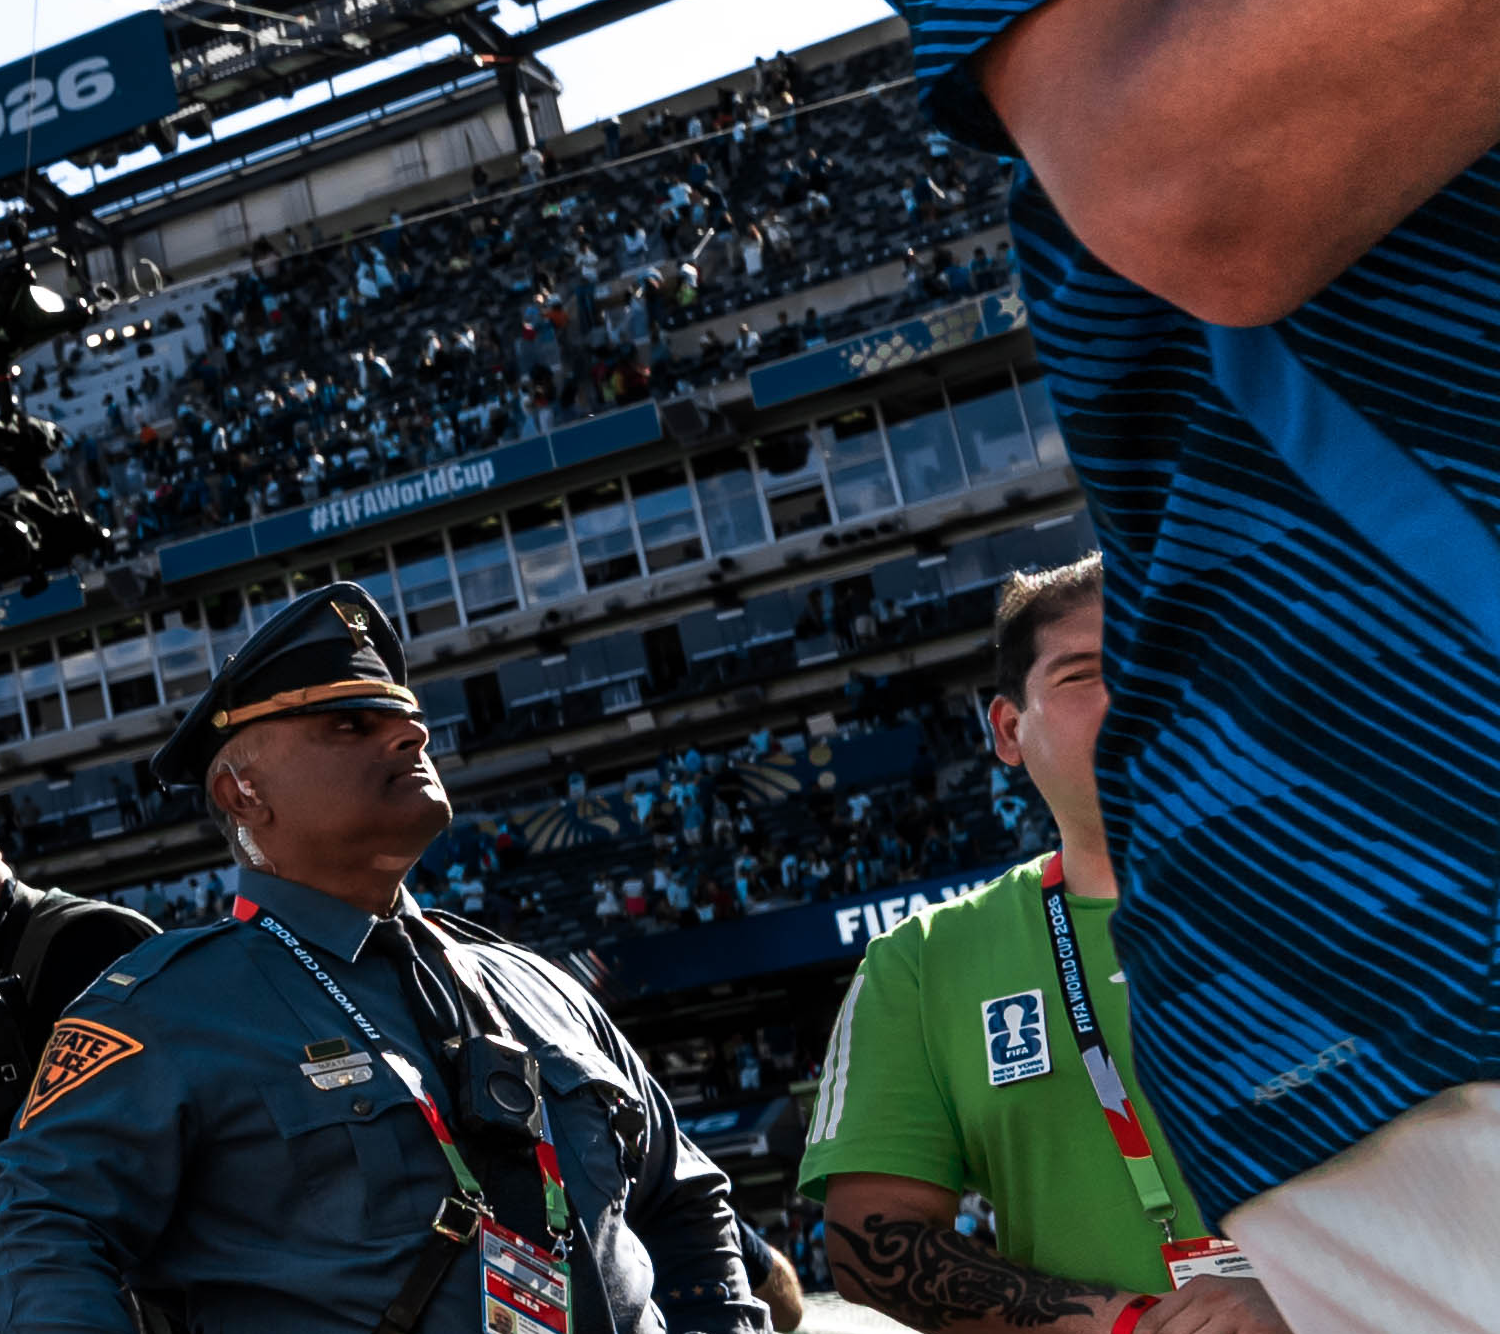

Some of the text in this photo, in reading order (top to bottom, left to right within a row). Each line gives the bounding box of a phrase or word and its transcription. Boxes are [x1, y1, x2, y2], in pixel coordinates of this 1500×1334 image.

[309, 458, 496, 534] #FIFAWorldCup
[260, 916, 380, 1040] FIFA WORLD CUP 2026
[1047, 894, 1093, 1033] FIFA WORLD CUP 2026
[53, 1029, 109, 1060] STATE
[1005, 1046, 1029, 1058] FIFA
